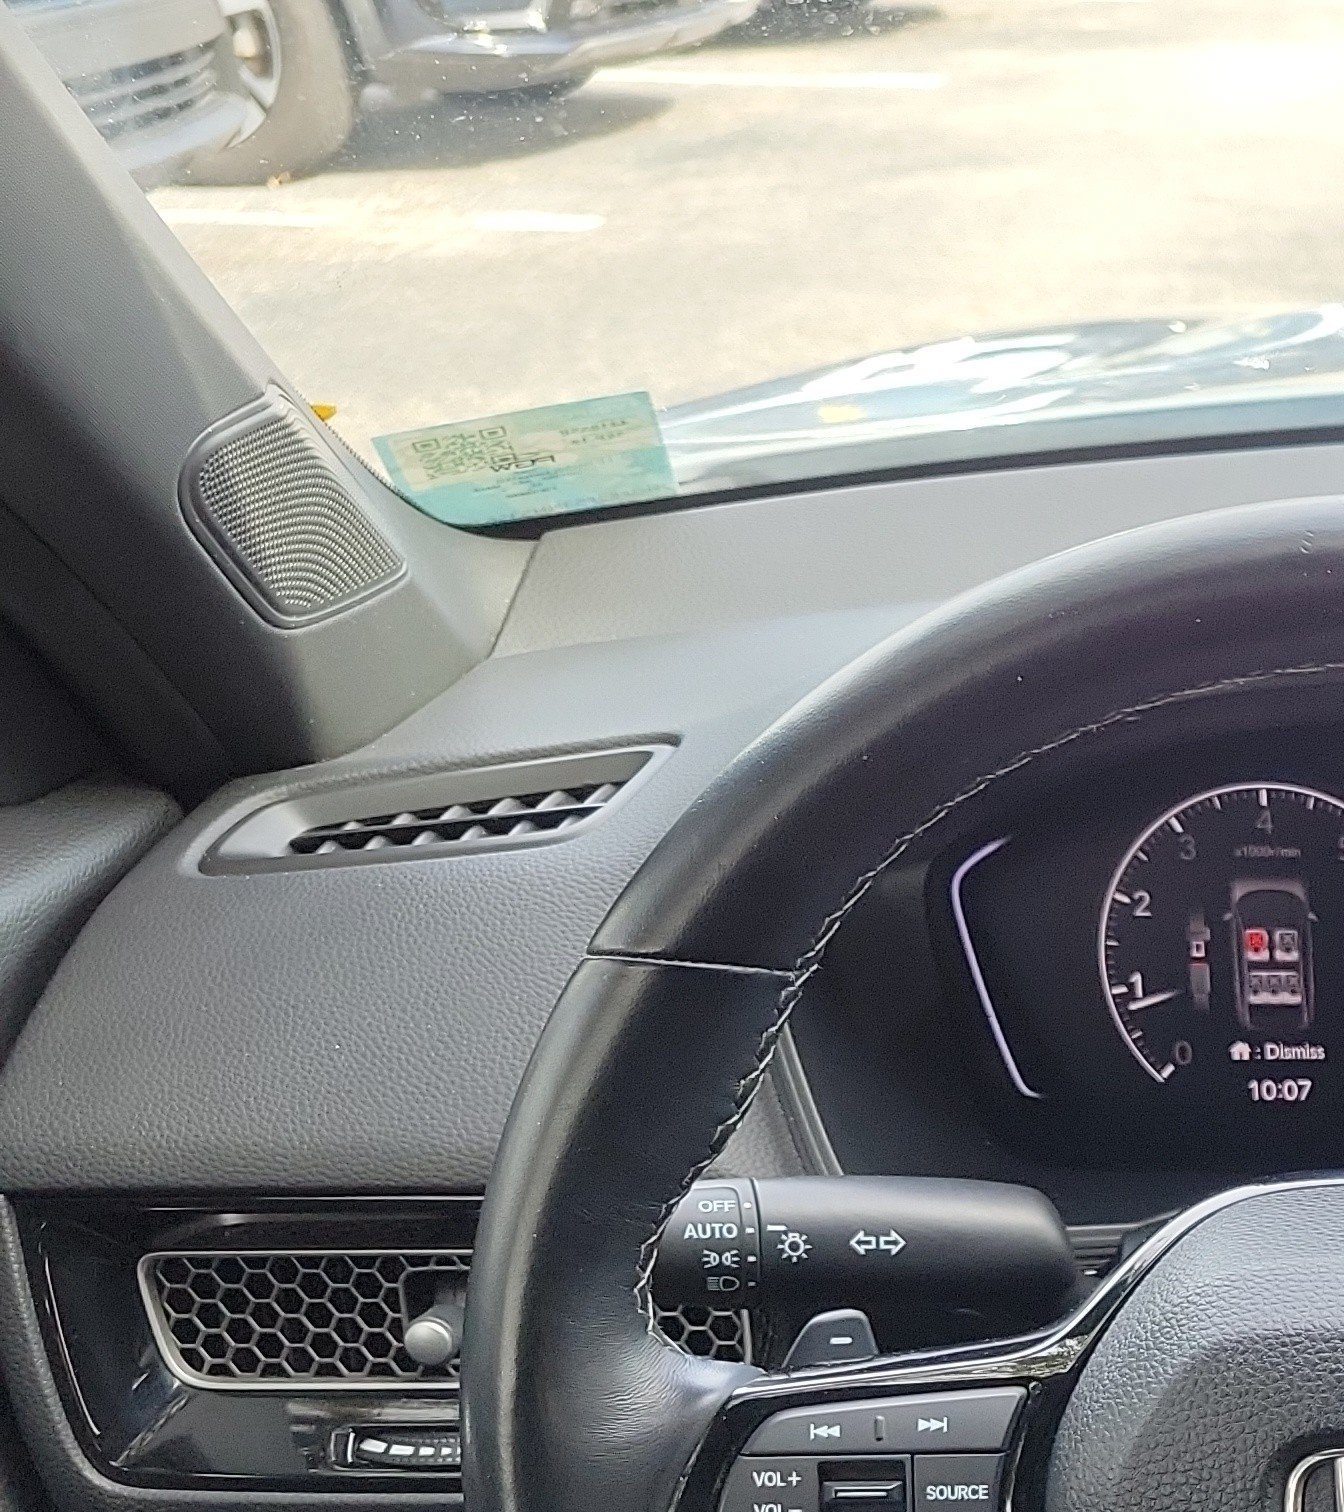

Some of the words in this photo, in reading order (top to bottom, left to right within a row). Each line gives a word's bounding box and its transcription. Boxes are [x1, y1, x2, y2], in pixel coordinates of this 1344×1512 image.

[1256, 809, 1274, 834] 4
[1180, 837, 1197, 861] 3
[1133, 892, 1152, 918] 2
[1129, 972, 1143, 998] 1
[1174, 1040, 1192, 1065] 0
[1265, 1043, 1326, 1061] Dismiss
[1247, 1078, 1312, 1102] 10:07
[698, 1199, 736, 1213] OFF
[683, 1223, 739, 1240] AUTO
[752, 1470, 802, 1488] VOL+
[925, 1484, 989, 1501] SOURCE
